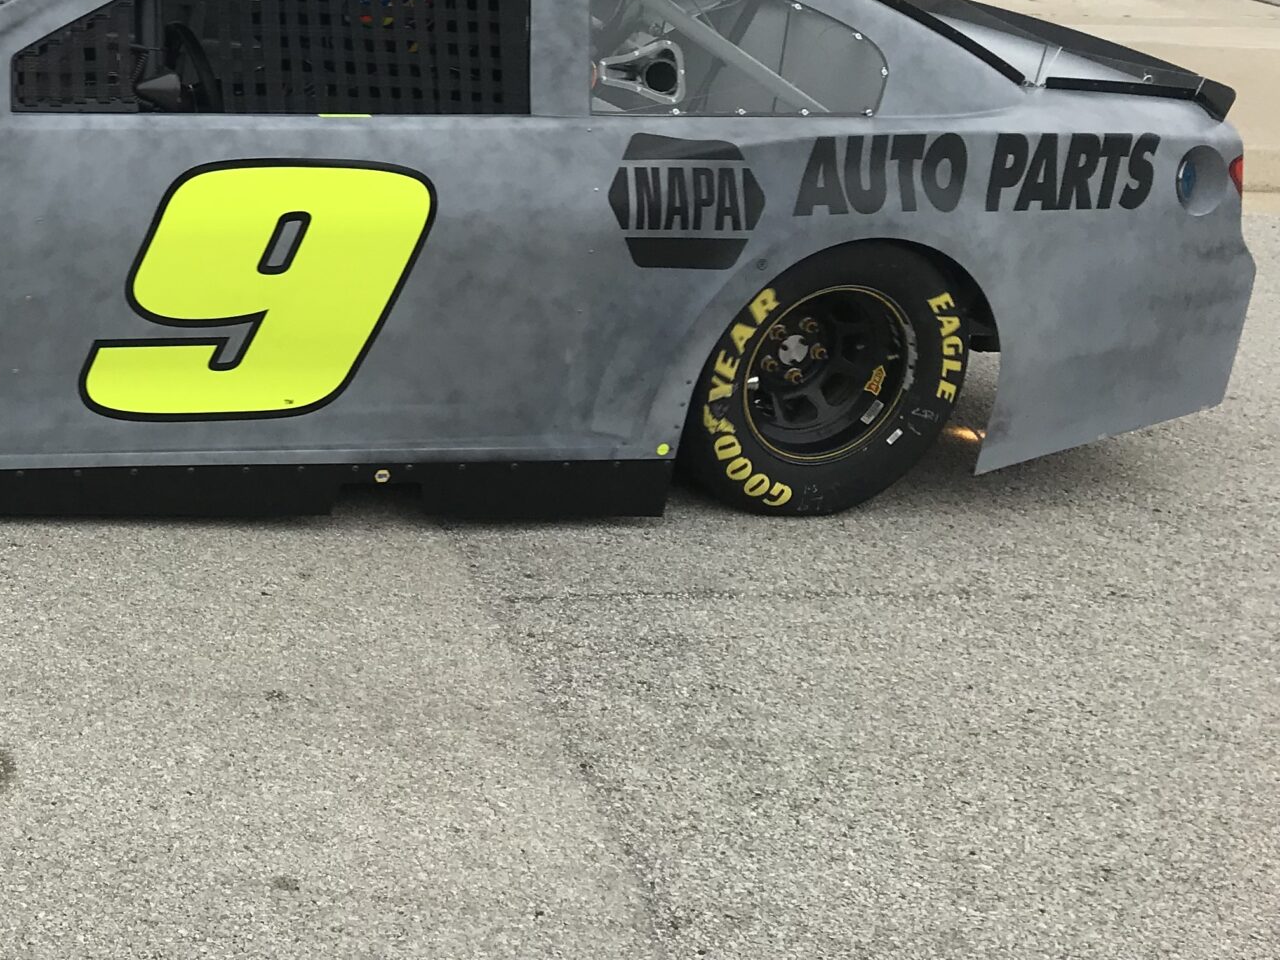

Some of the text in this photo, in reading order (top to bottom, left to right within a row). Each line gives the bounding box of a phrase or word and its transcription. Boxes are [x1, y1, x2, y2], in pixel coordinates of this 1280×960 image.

[634, 166, 743, 231] NAPA
[792, 132, 1161, 217] AUTO PARTS
[78, 157, 437, 422] 9
[703, 287, 792, 507] GOODYEAR
[926, 291, 964, 403] EAGLE
